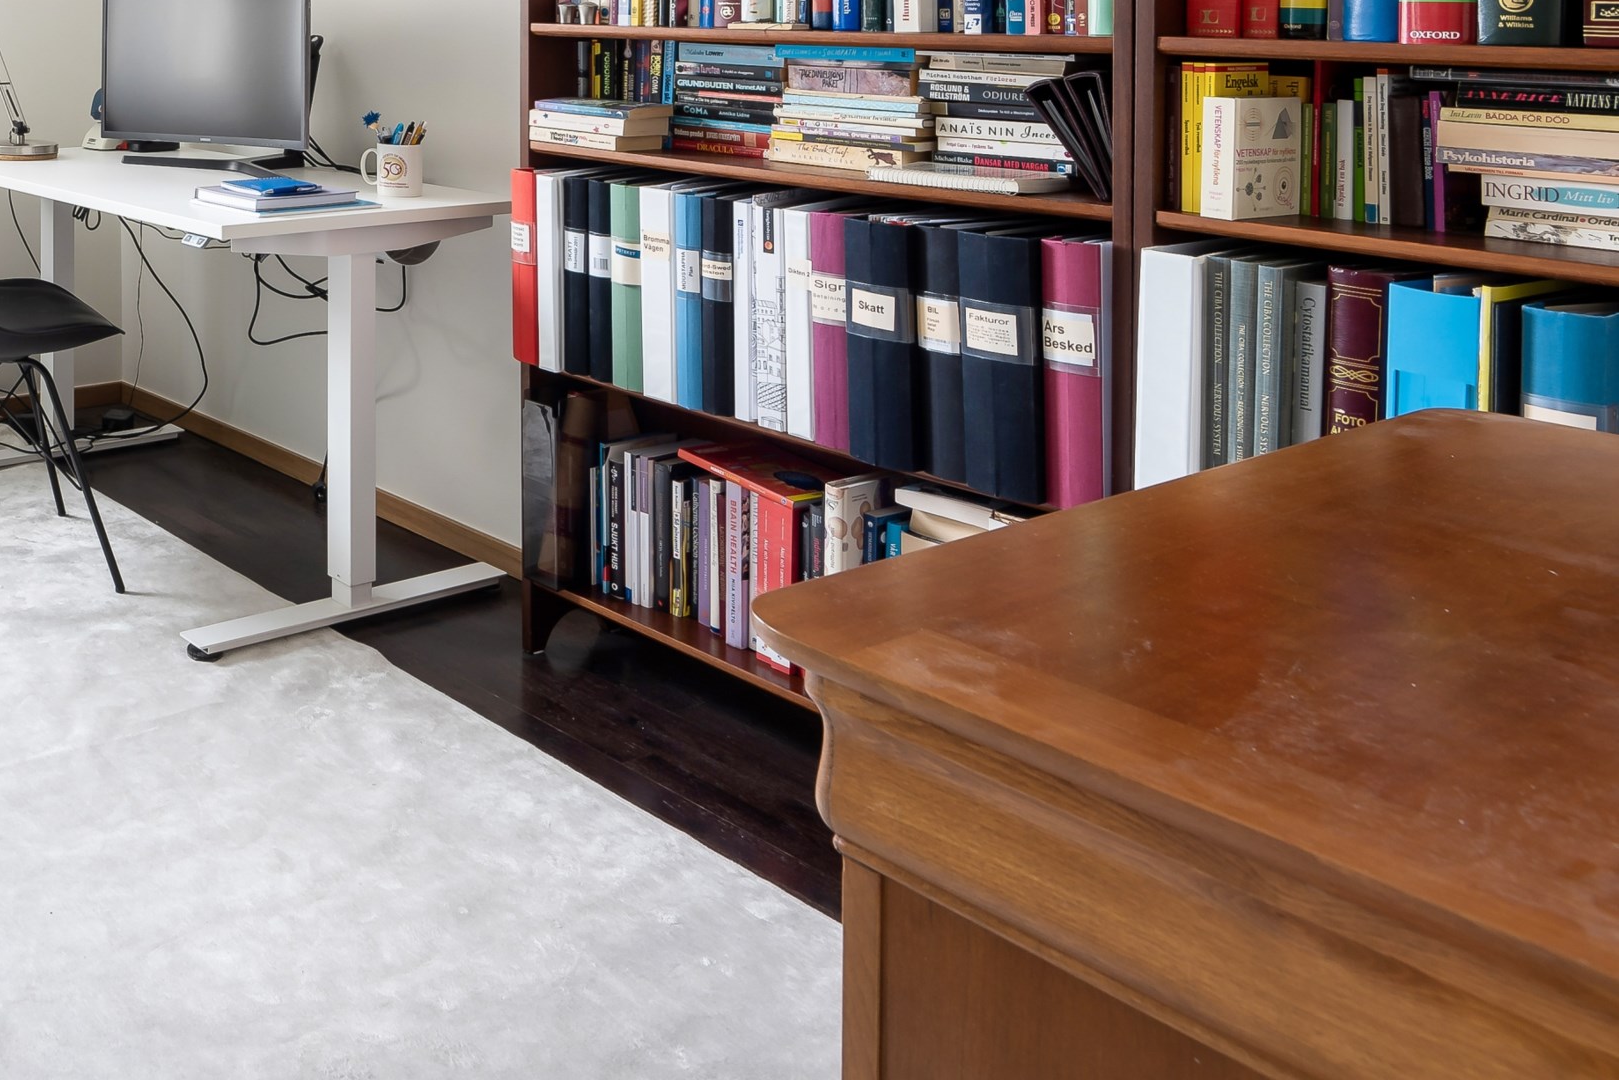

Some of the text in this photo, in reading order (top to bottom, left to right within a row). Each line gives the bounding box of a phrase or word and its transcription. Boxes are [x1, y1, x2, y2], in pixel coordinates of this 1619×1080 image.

[1499, 14, 1532, 22] Williams
[1505, 21, 1534, 29] Wilkins
[1410, 30, 1460, 40] OXFORD
[926, 71, 951, 79] Michael
[952, 73, 983, 81] Robotham
[1225, 73, 1259, 91] Engelsk
[677, 78, 733, 89] GRUNDBULTEN
[930, 83, 963, 93] ROSLUND
[929, 91, 970, 102] HELLSTRÖM
[982, 90, 1030, 101] ODJURE
[1565, 93, 1610, 109] NATTENS
[1485, 111, 1570, 125] BÄDDA FÖR DÖD
[939, 122, 1014, 137] ANAÏS NIN
[1214, 105, 1222, 149] VETENSKAP
[696, 143, 734, 154] DRACULA
[796, 143, 828, 154] The Book
[1236, 147, 1272, 158] VETENSKAP
[934, 153, 956, 161] Michael
[974, 155, 1002, 167] DANSAR
[1003, 159, 1018, 169] MED
[1020, 161, 1048, 171] VARGAR
[1442, 150, 1535, 168] Psykohistoria
[381, 161, 403, 179] 50
[1484, 181, 1615, 205] INGRID Mitt liv
[1498, 208, 1580, 224] Marie Cardinal
[643, 234, 669, 245] Bromma
[643, 243, 664, 253] Vägen
[787, 267, 804, 276] Dikten
[858, 300, 885, 315] Skatt
[927, 306, 939, 315] BIL
[968, 312, 1010, 325] Fakturor
[1044, 335, 1093, 354] Besked
[1261, 281, 1273, 435] THE CIBA COLLECTION NERVOUS
[1299, 297, 1316, 412] Cytostatikamanual
[1213, 271, 1223, 456] THE CIBA COLLECTION NERVOUS SYSTEM
[1334, 412, 1366, 427] FOTO
[729, 500, 737, 575] BRAIN HEALTH
